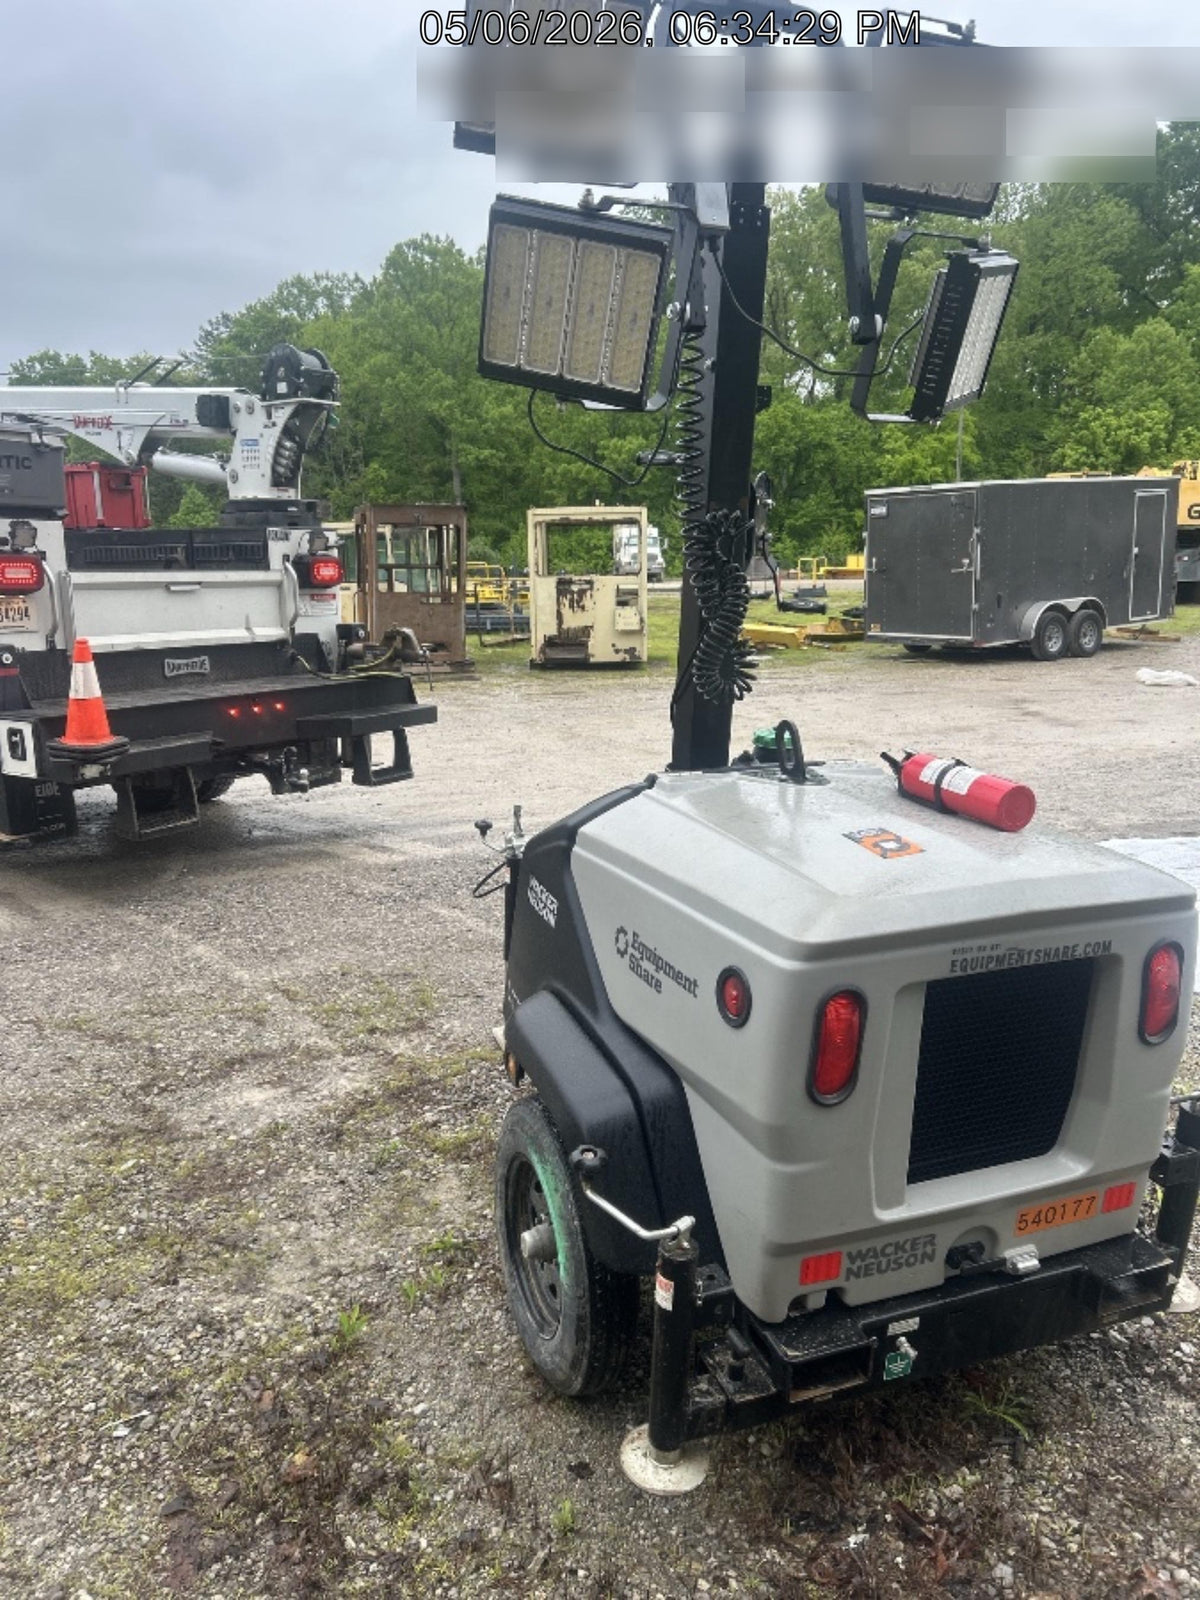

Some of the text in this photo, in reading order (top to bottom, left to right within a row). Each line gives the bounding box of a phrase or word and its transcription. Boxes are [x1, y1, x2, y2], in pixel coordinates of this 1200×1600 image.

[0, 455, 32, 470] TIC
[628, 952, 663, 994] Share
[630, 930, 699, 998] Equipment
[950, 940, 1113, 974] EQUIPMENTSHARE.COM
[1017, 1195, 1097, 1231] 540177
[844, 1248, 936, 1282] NEUSON
[845, 1233, 937, 1265] WACKER
